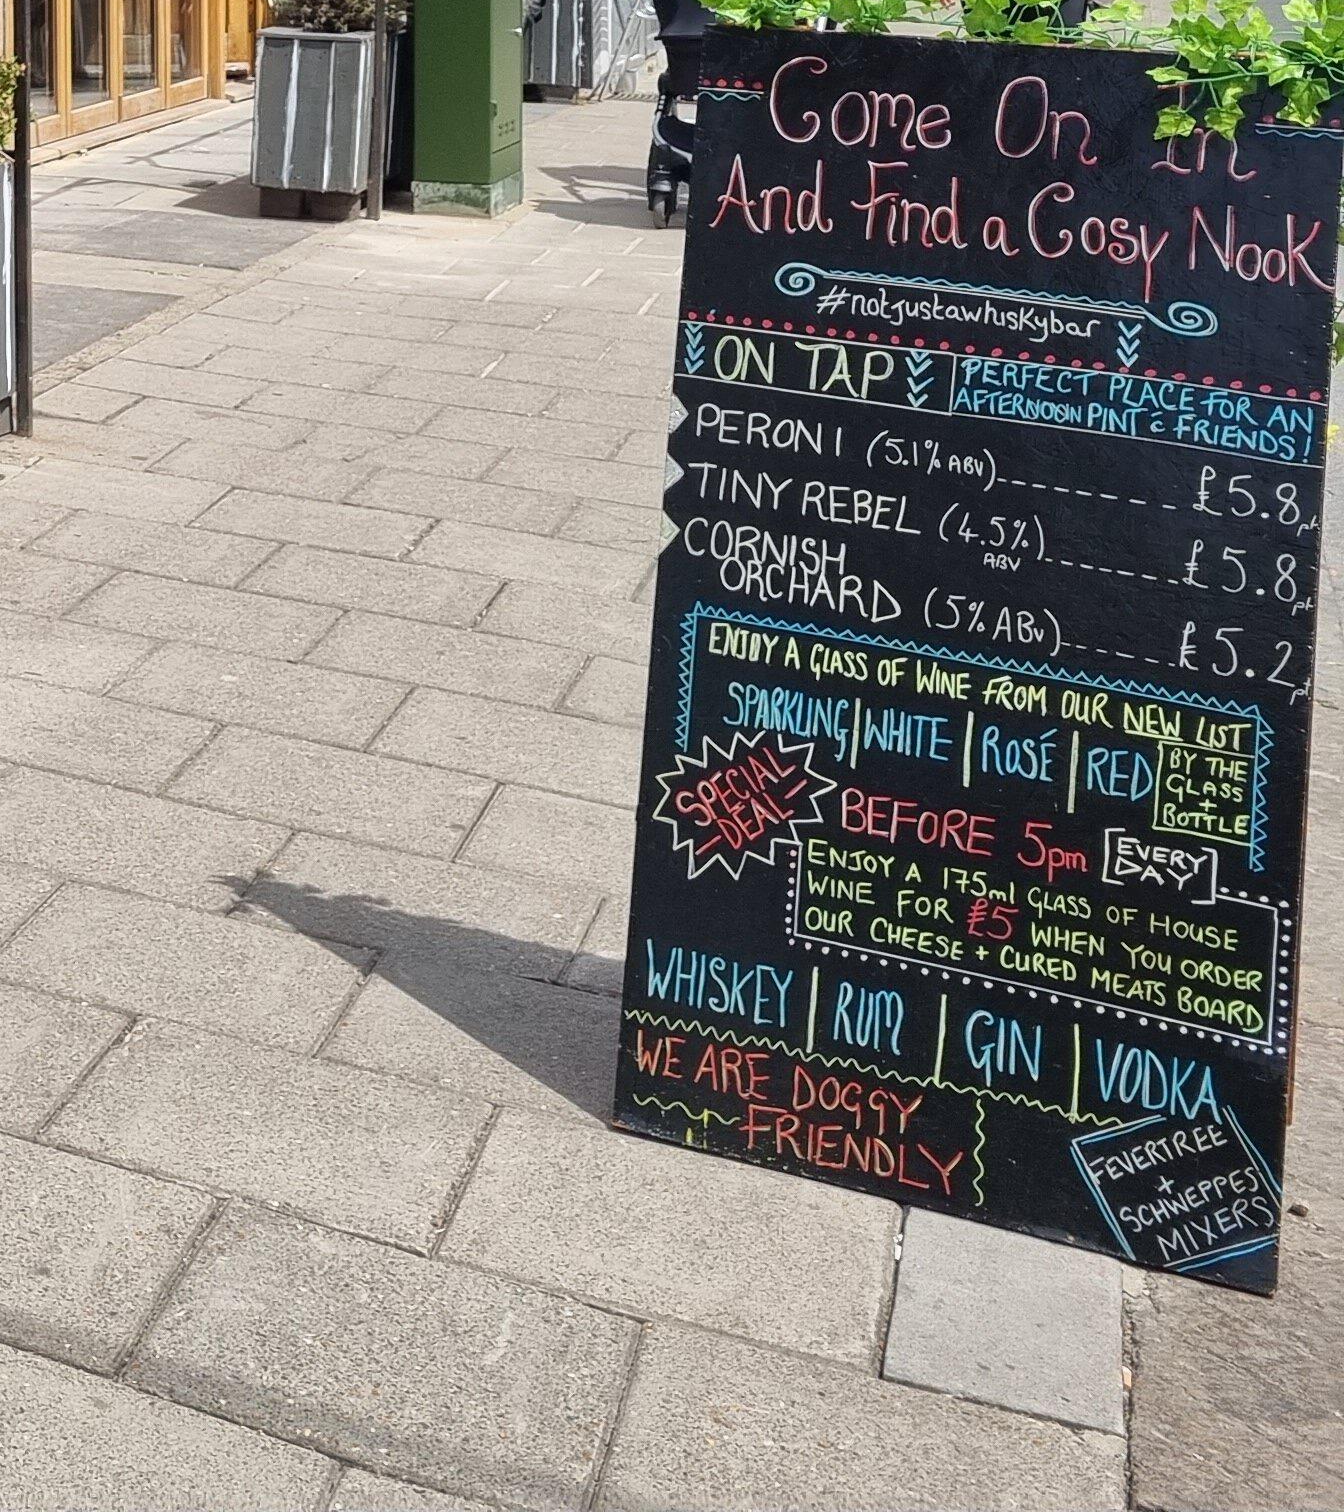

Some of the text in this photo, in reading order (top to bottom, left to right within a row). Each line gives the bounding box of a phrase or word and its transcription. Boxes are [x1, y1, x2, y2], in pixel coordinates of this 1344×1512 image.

[769, 55, 1257, 182] Come On In
[708, 153, 834, 235] And
[850, 160, 969, 249] Find
[983, 216, 1020, 257] a
[1027, 181, 1170, 303] Cosy
[714, 335, 895, 399] ON TAP
[961, 359, 1314, 434] PERFECT PLACE FOR AN
[696, 403, 842, 457] PERONI
[953, 387, 1082, 424] AFTERNOON
[1087, 402, 1148, 437] PINT
[688, 461, 793, 510] TINY
[802, 480, 922, 535] REBEL
[939, 502, 1046, 562] (4.5%)
[684, 516, 847, 575] CORNISH
[983, 552, 1022, 572] ABV
[719, 556, 902, 623] ORCHARD
[708, 622, 1252, 751] ENJOY A GLASS OF WINE FROM OUR NEW LIST
[675, 747, 798, 827] SPECIAL
[864, 707, 953, 761] WHITE
[981, 724, 1058, 782] ROSÉ
[1087, 747, 1153, 802] RED
[1169, 748, 1249, 783] BY THE
[715, 792, 795, 849] DEAL
[1162, 803, 1250, 835] BOTTLE
[1165, 774, 1244, 803] GLASS
[841, 787, 1089, 883] BEFORE 5pm
[1116, 837, 1208, 874] EVERY
[807, 839, 1239, 951] ENJOY A 175ml GLASS OF HOUSE
[1114, 856, 1193, 891] DAY
[807, 870, 1263, 993] WINE FOR £5 WHEN YOU ORDER
[804, 906, 1264, 1033] OUR CHEESE + CURED MEATS BOARD
[645, 937, 1223, 1126] WHISKEY RUM GIN VODKA
[635, 1029, 924, 1136] WE ARE DOGGY
[738, 1103, 964, 1196] FRIENDLY
[1089, 1124, 1228, 1186] FEVERTREE
[1119, 1166, 1260, 1233] SCHWEPPES
[1157, 1175, 1175, 1195] +
[1156, 1196, 1276, 1261] MIXERS
